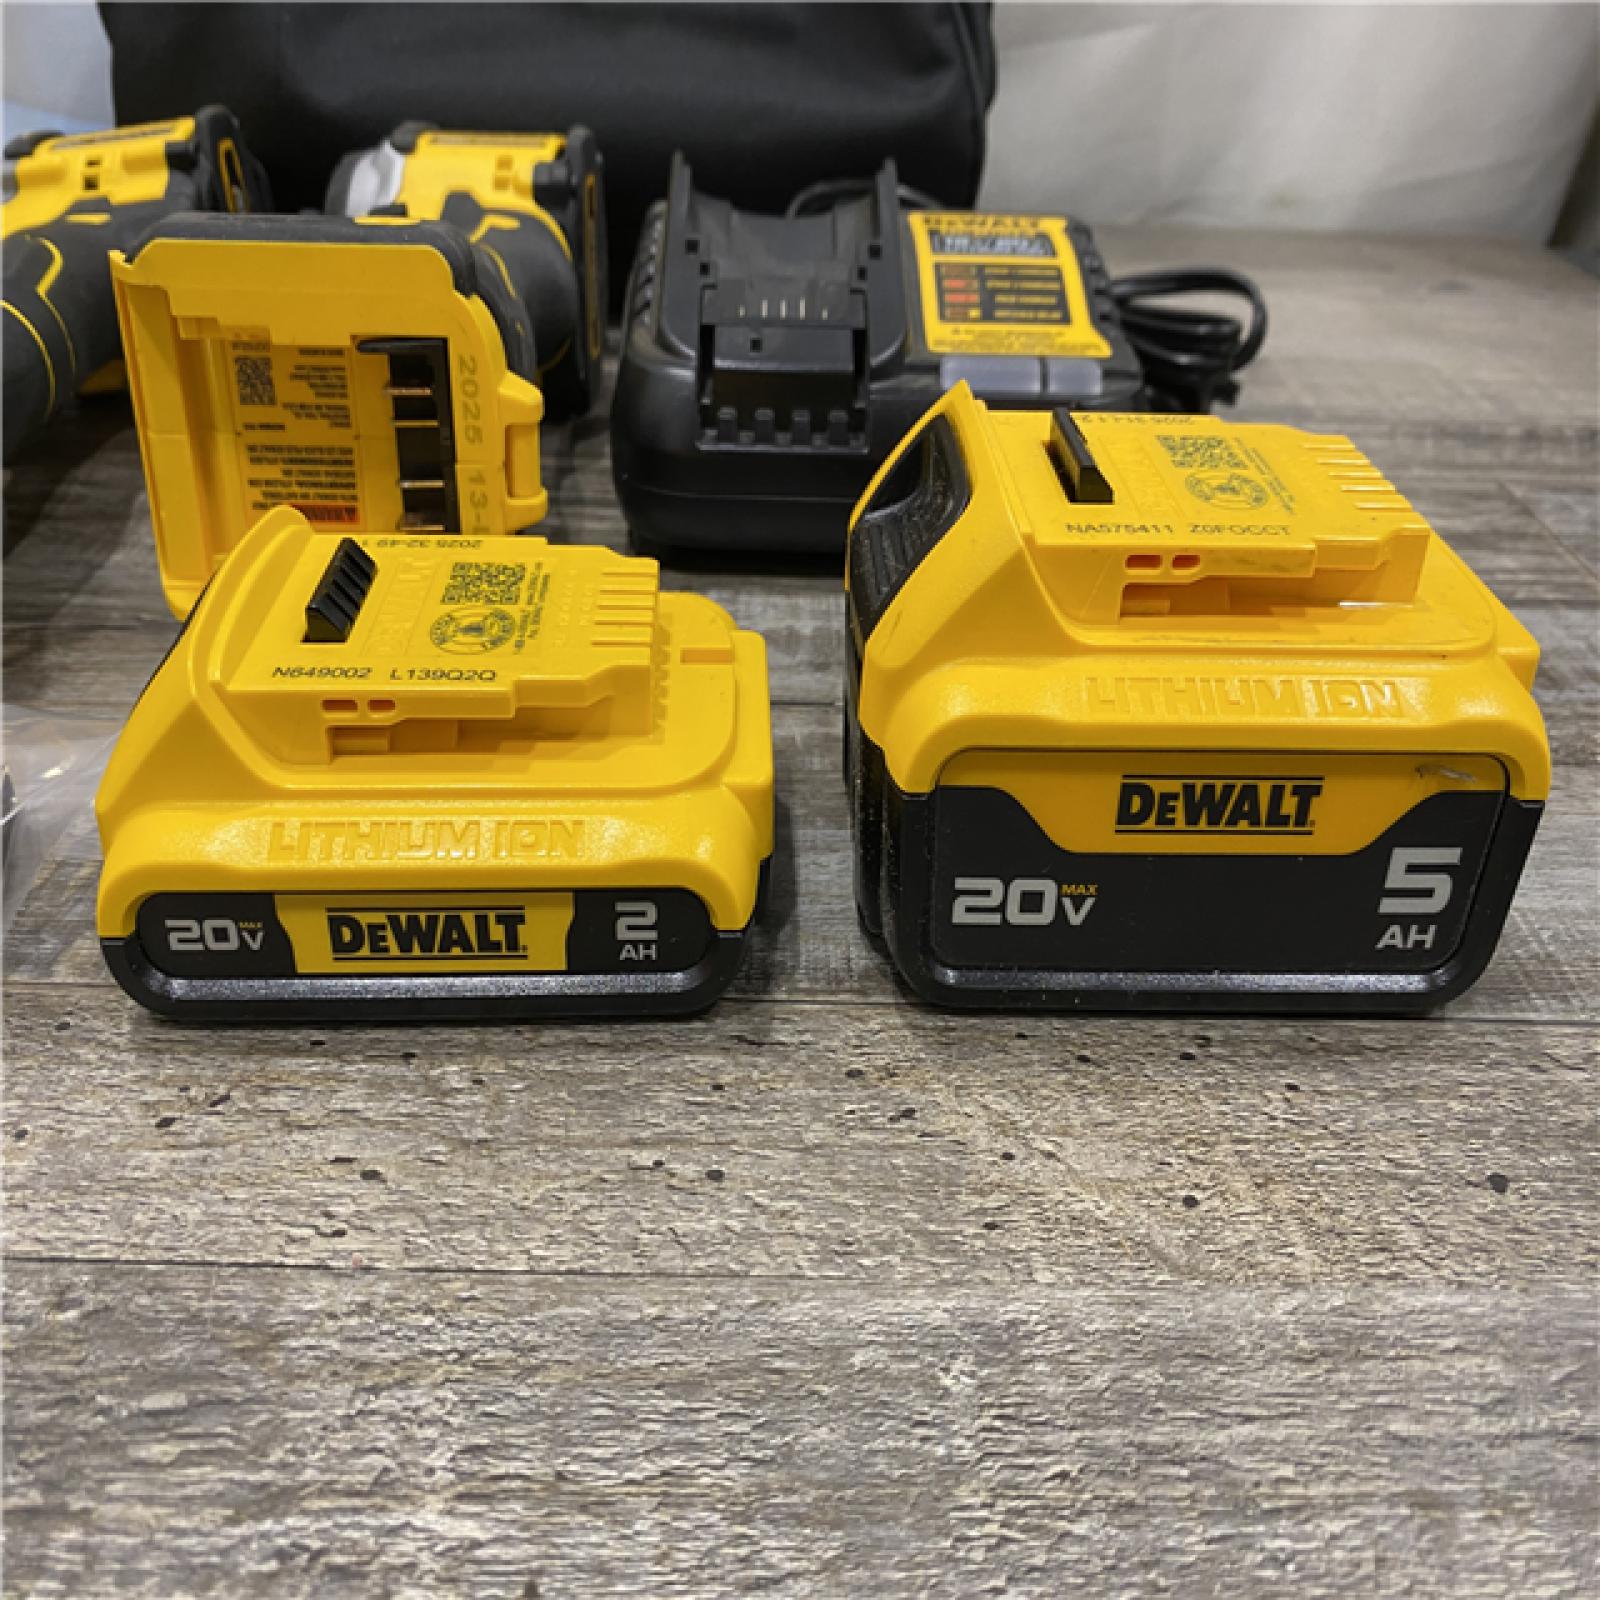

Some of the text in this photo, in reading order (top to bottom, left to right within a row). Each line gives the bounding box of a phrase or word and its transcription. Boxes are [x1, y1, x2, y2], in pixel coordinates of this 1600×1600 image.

[459, 355, 483, 444] 2025
[1084, 675, 1402, 719] LITHIUM ION
[1114, 781, 1324, 829] DEWALT
[266, 818, 586, 861] LITHIUM ION
[1062, 884, 1098, 896] MAX
[1378, 846, 1464, 915] 5
[328, 914, 527, 954] DEWALT
[614, 902, 658, 941] 2
[1375, 923, 1436, 950] AH
[618, 942, 658, 962] AH
